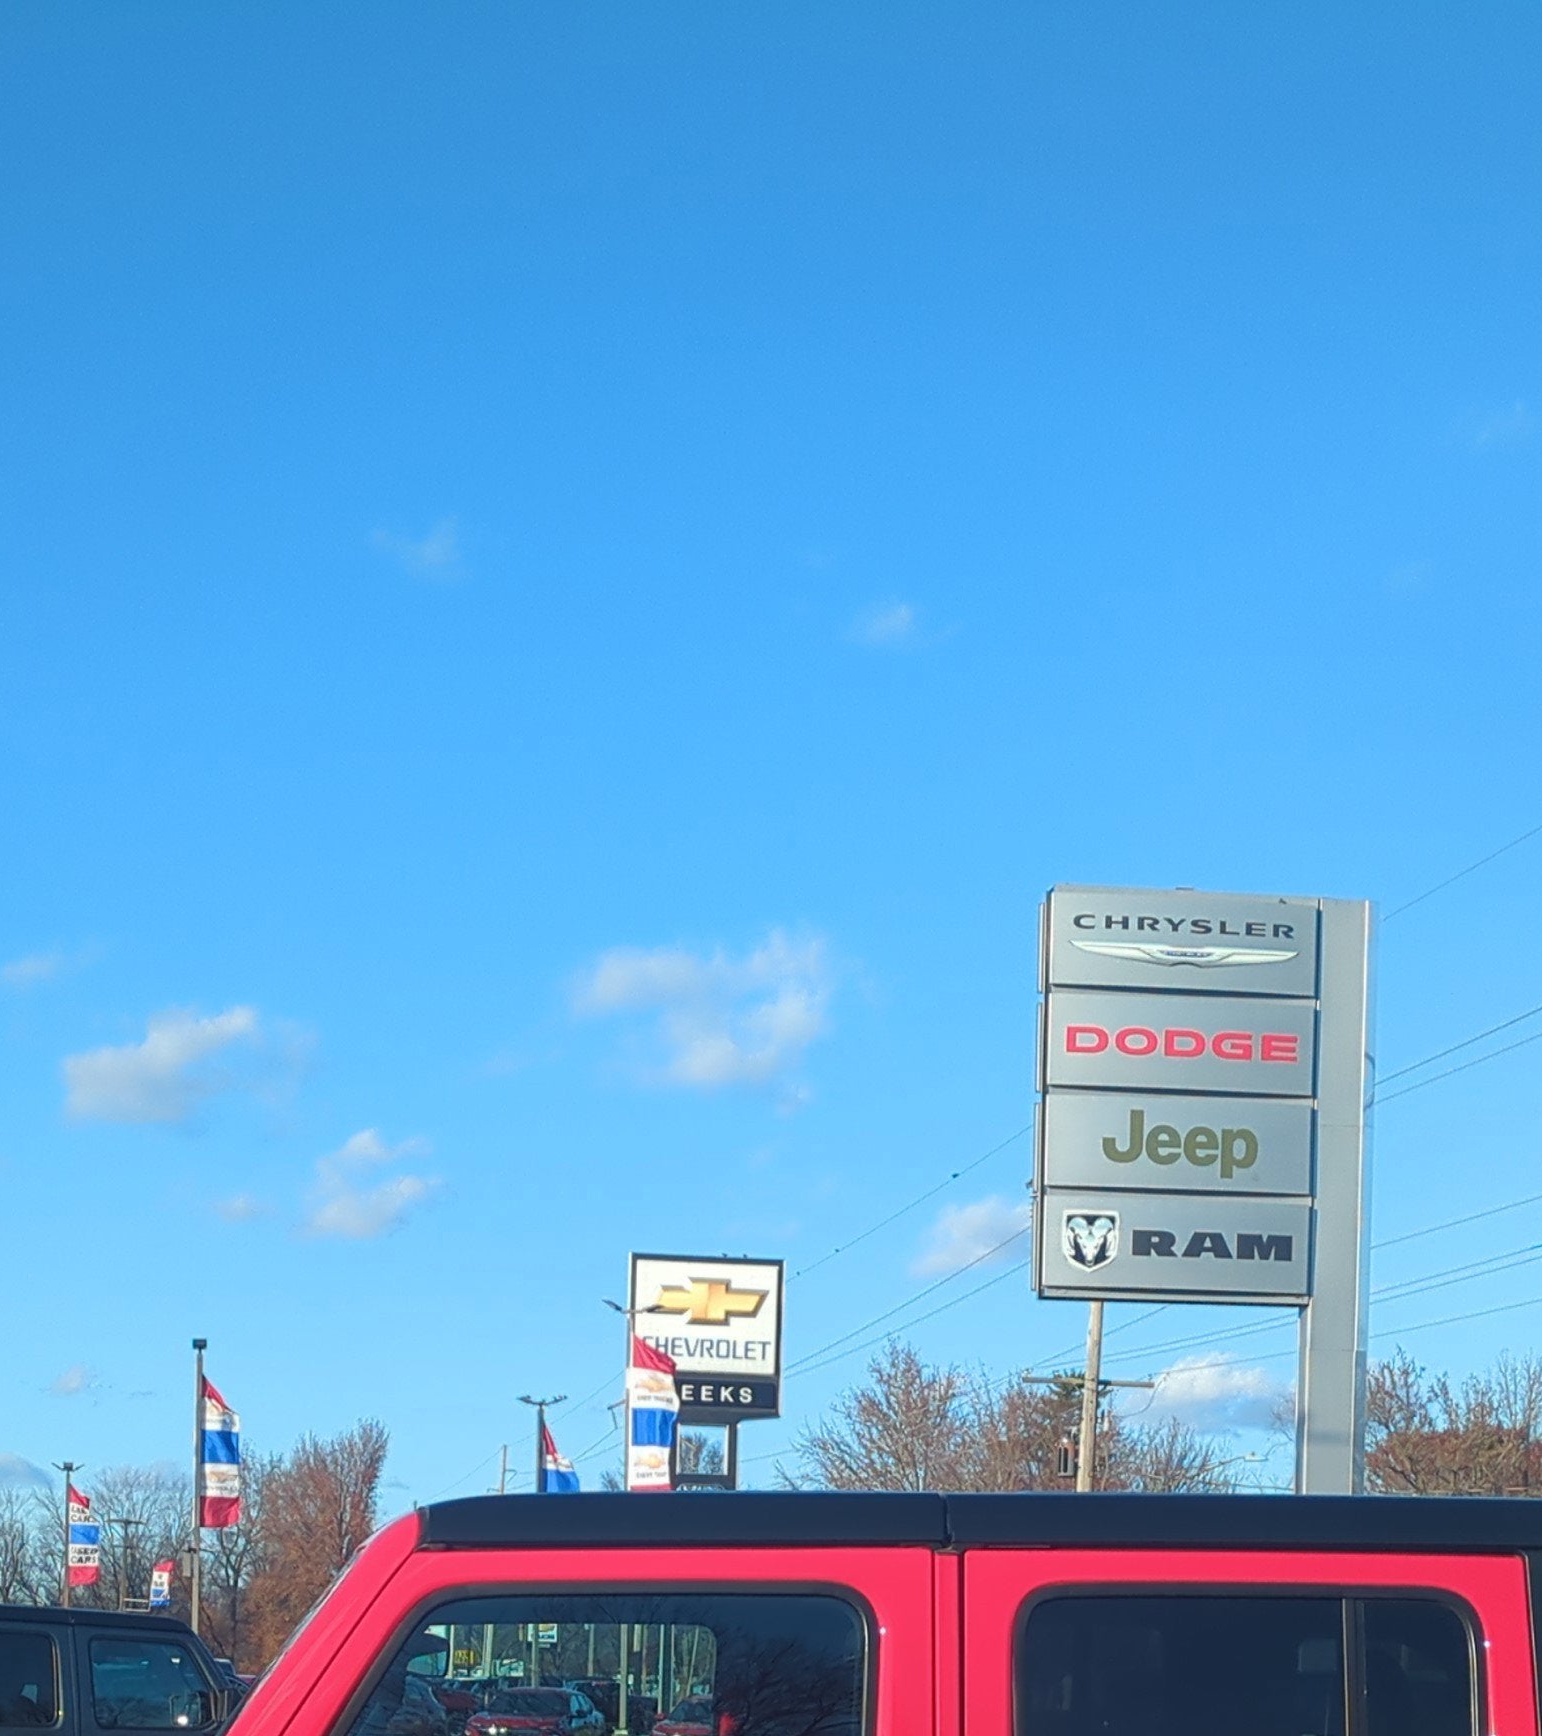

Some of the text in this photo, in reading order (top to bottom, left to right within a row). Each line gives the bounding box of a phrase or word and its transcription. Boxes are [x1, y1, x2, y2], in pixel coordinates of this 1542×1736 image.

[1073, 913, 1295, 940] CHRYSLER
[1065, 1025, 1298, 1063] DODGE
[1102, 1109, 1259, 1179] Jeep
[1131, 1228, 1294, 1263] RAM
